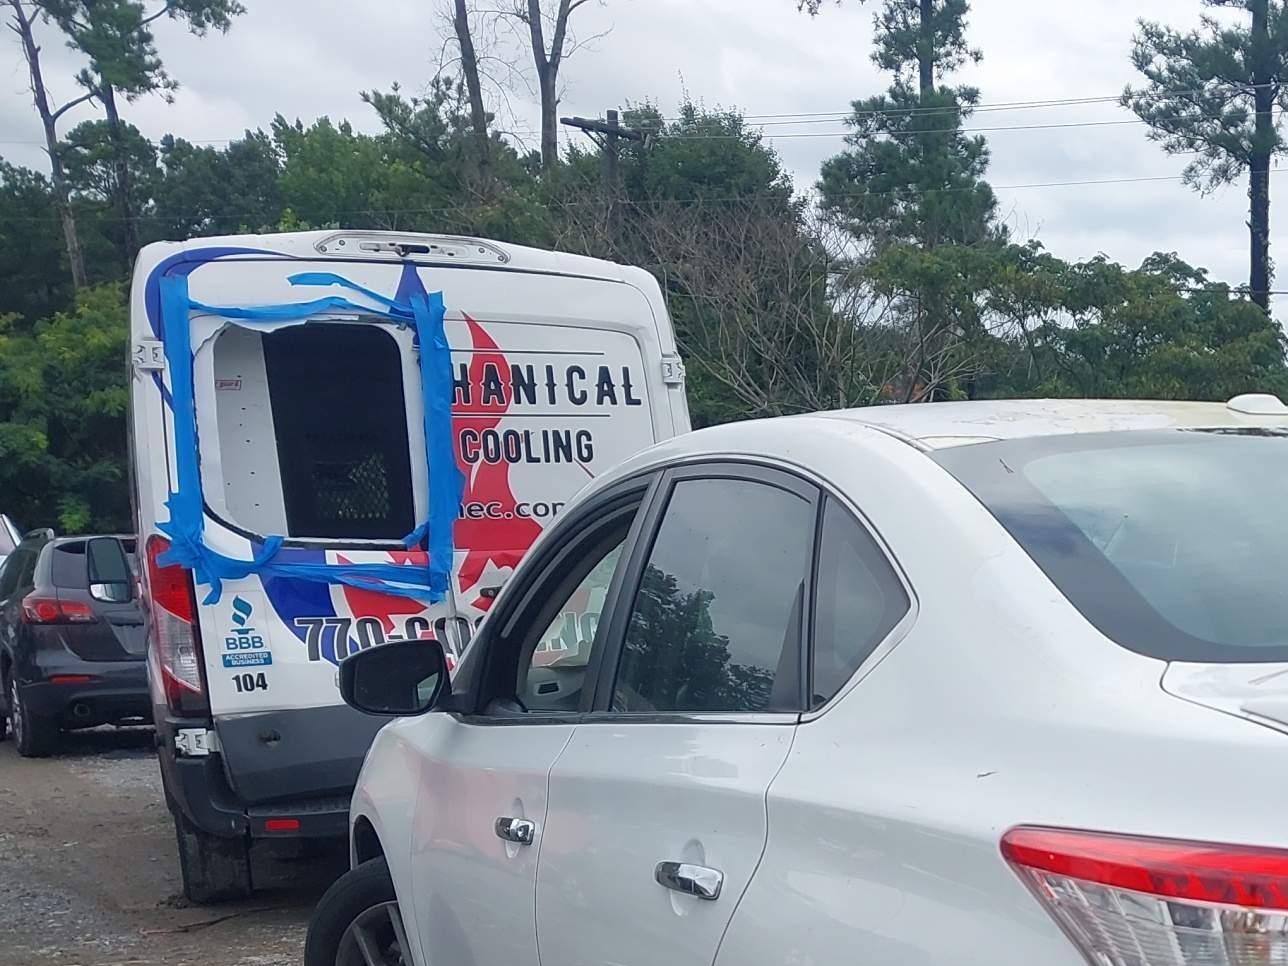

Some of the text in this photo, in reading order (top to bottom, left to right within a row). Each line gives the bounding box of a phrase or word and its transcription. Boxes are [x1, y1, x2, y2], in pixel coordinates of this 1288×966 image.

[460, 429, 595, 465] COOLING
[225, 635, 264, 650] BBB
[225, 653, 269, 662] ACCREDITED
[231, 672, 268, 693] 104
